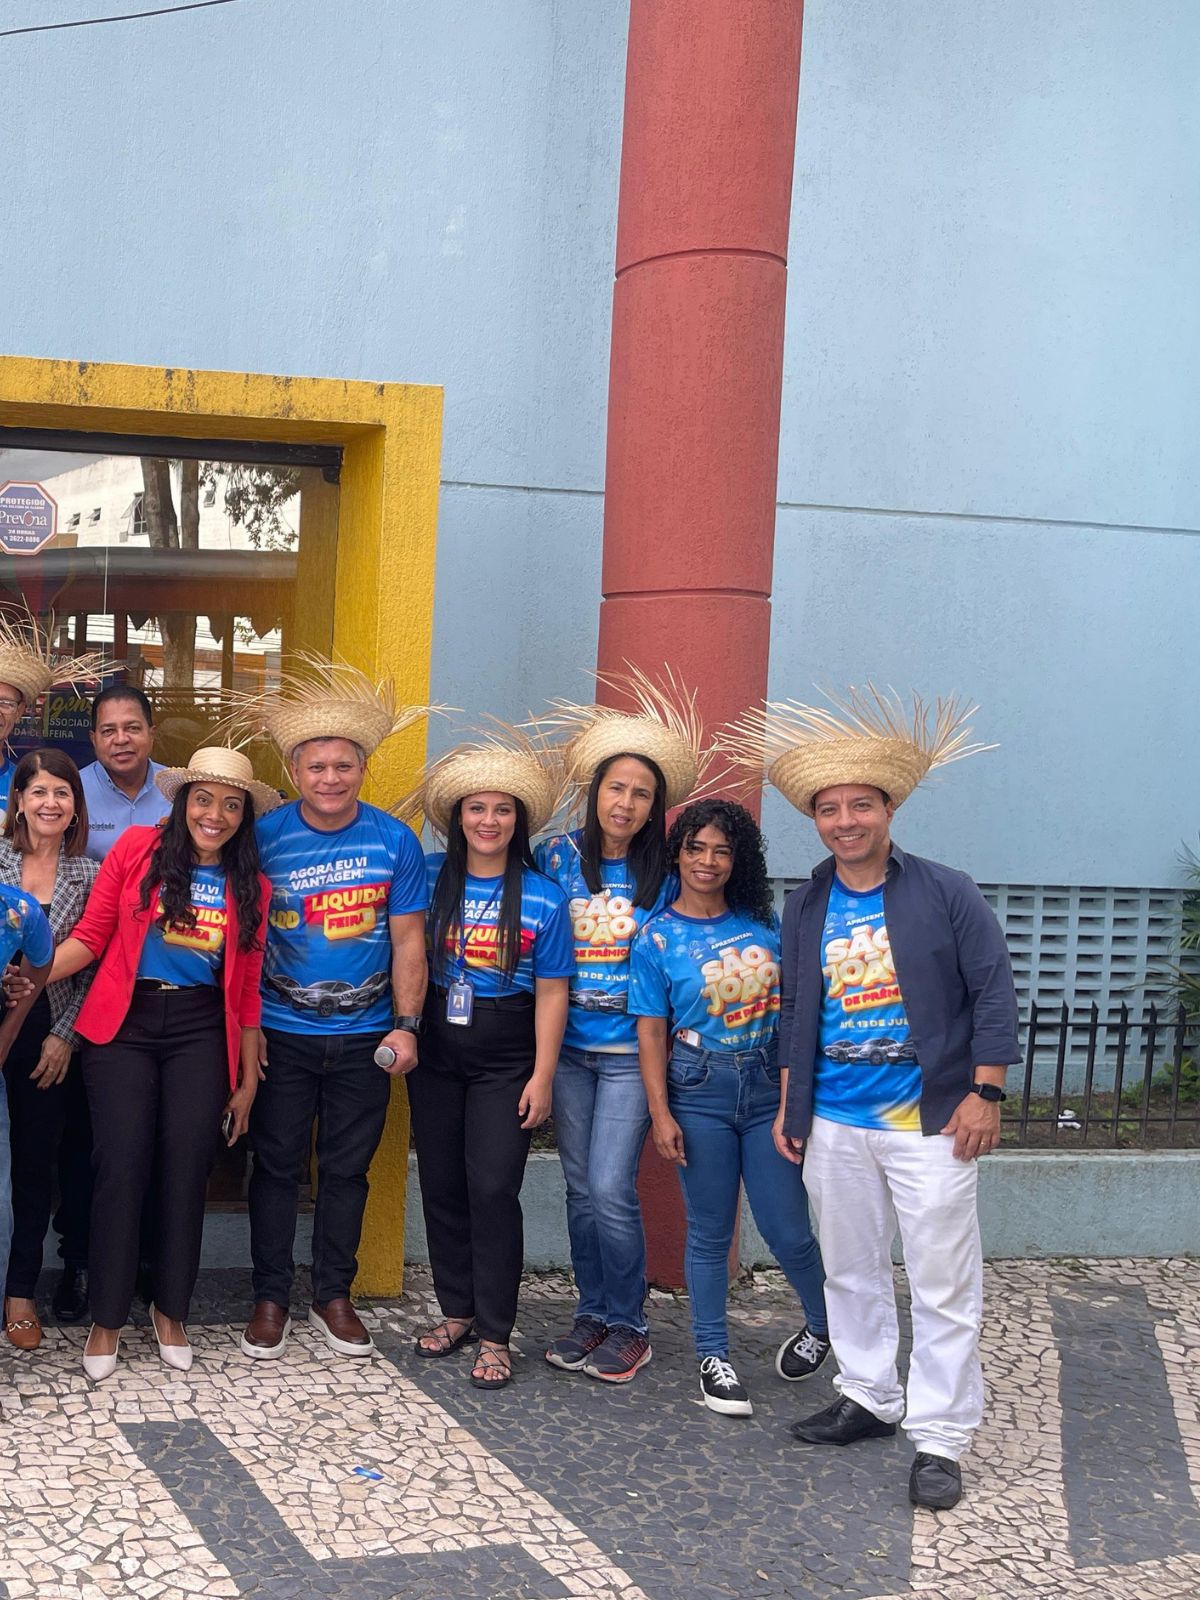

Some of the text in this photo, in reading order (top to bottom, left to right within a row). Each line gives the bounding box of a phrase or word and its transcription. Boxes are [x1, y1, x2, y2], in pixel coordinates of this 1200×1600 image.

[0, 497, 46, 507] PROTEGIDO
[49, 717, 92, 728] SSOCIAD
[49, 729, 74, 739] FEIRA
[289, 856, 368, 881] AGORA EU VI
[291, 868, 365, 891] VANTAGEM!
[207, 884, 220, 895] VI
[311, 886, 386, 912] LIQUIDA
[569, 891, 634, 918] SÃO
[327, 911, 365, 930] FEIRA
[574, 916, 637, 946] OÃO
[464, 949, 498, 960] EIRA
[588, 947, 630, 958] PRÊMIO
[701, 945, 773, 985] SÃO
[701, 961, 780, 1017] JOÃO
[844, 996, 861, 1007] DE
